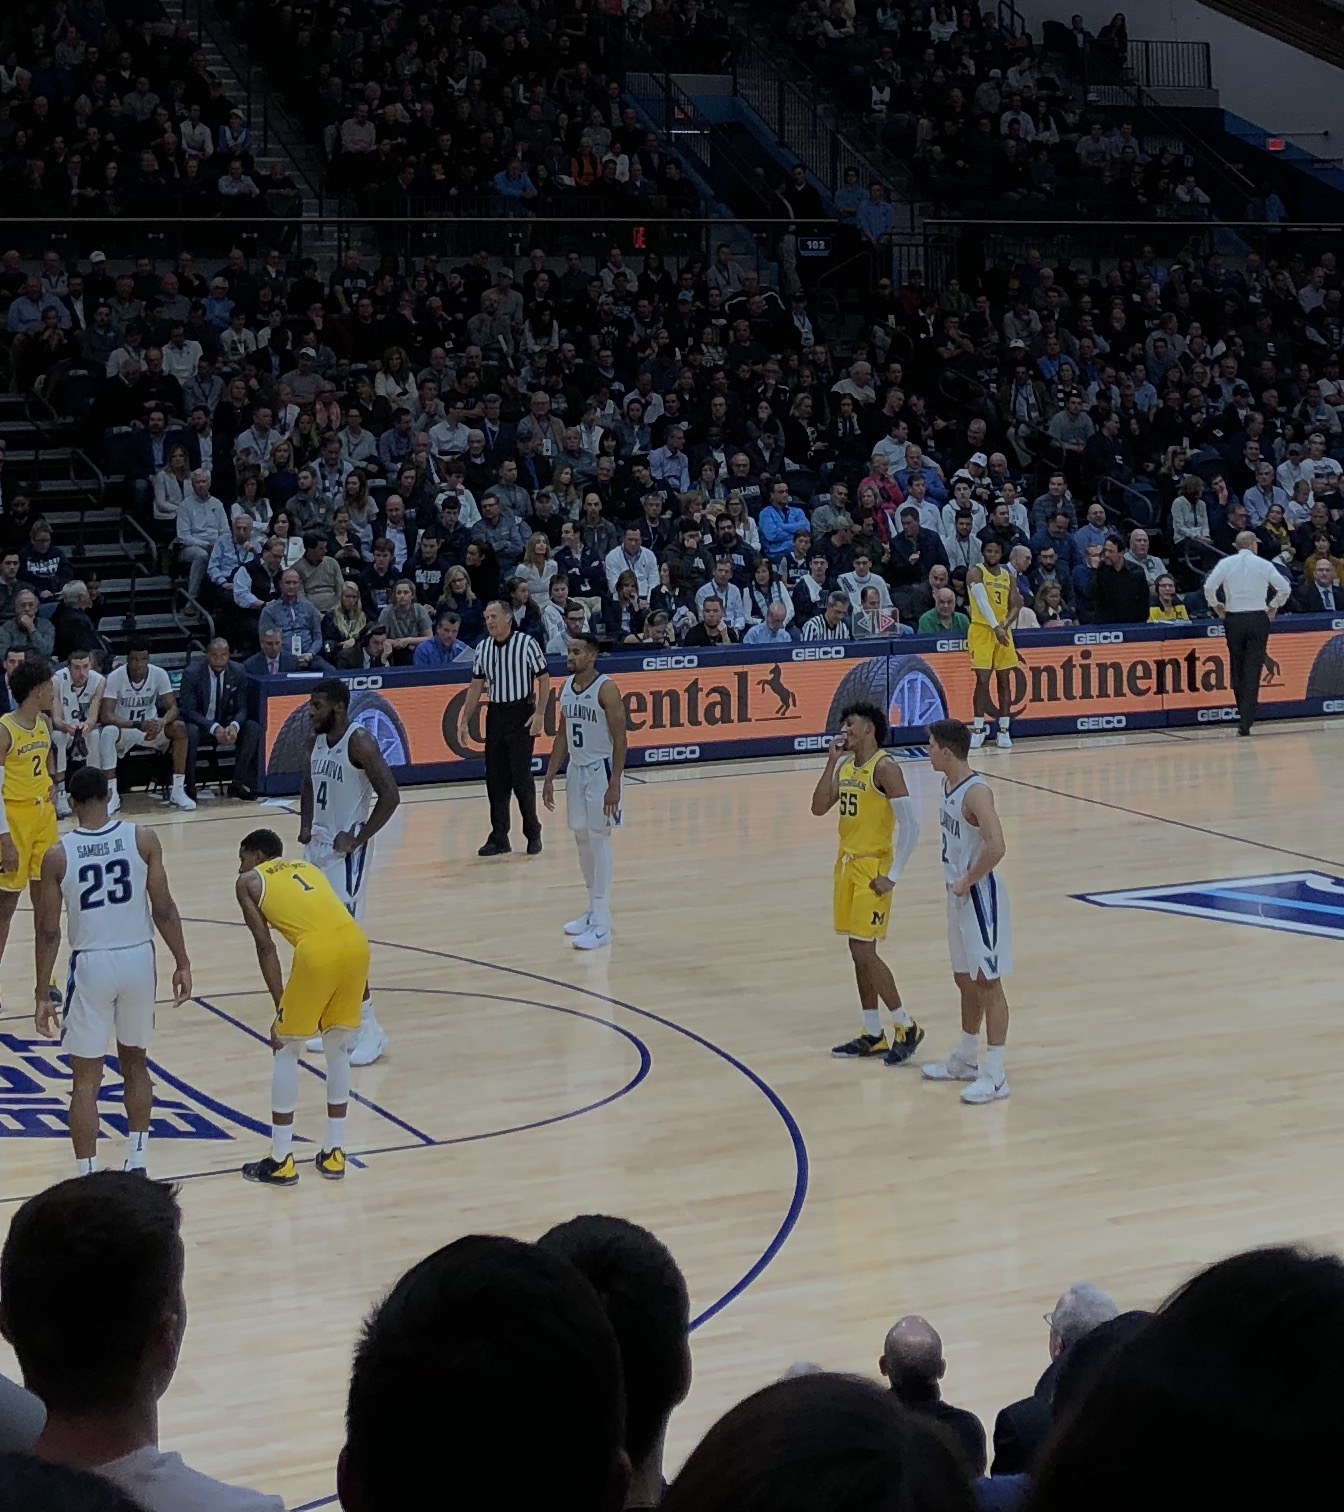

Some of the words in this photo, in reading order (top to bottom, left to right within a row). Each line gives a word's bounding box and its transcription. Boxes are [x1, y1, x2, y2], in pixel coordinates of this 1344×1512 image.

[806, 240, 826, 250] 102
[995, 590, 1004, 605] 3
[1074, 631, 1125, 646] GEICO
[642, 654, 699, 671] GEICO
[791, 646, 846, 661] GEICO
[129, 708, 146, 721] 15
[1075, 714, 1129, 730] GEICO
[572, 722, 584, 748] 5
[644, 744, 702, 763] GEICO
[31, 754, 42, 777] 2
[316, 780, 328, 811] 4
[839, 791, 859, 817] 55
[77, 857, 134, 912] 23
[292, 872, 315, 892] 1
